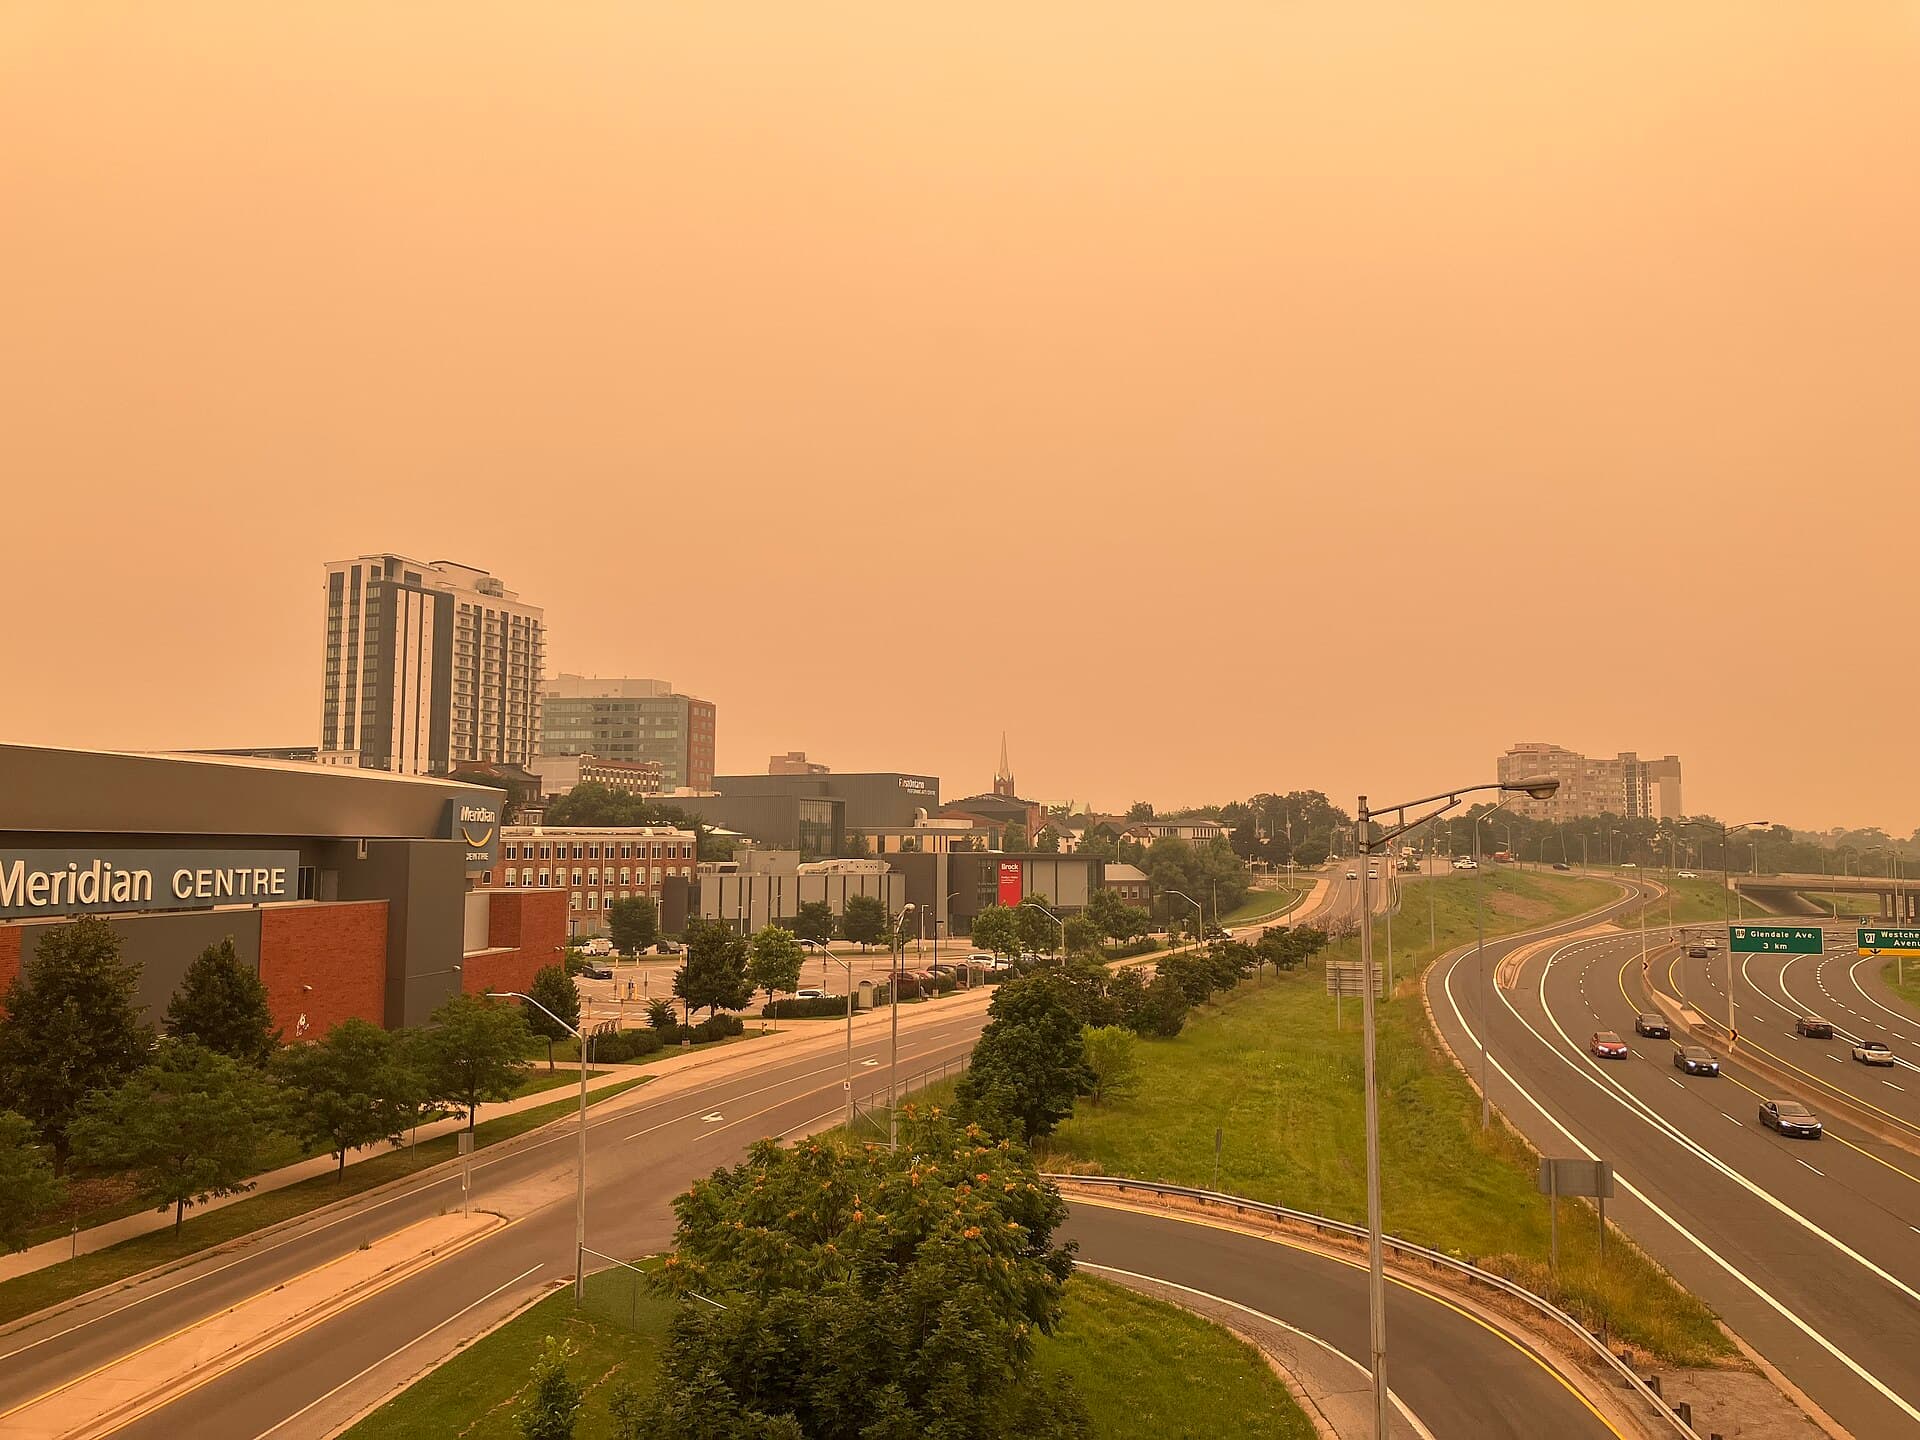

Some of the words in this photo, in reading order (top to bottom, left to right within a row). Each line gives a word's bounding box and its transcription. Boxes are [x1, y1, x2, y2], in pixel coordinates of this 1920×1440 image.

[460, 805, 496, 823] Meridian
[0, 859, 153, 907] Meridian
[172, 868, 286, 899] CENTRE
[1750, 930, 1790, 938] Glendale
[1795, 931, 1816, 939] Ave.
[1774, 942, 1788, 950] km
